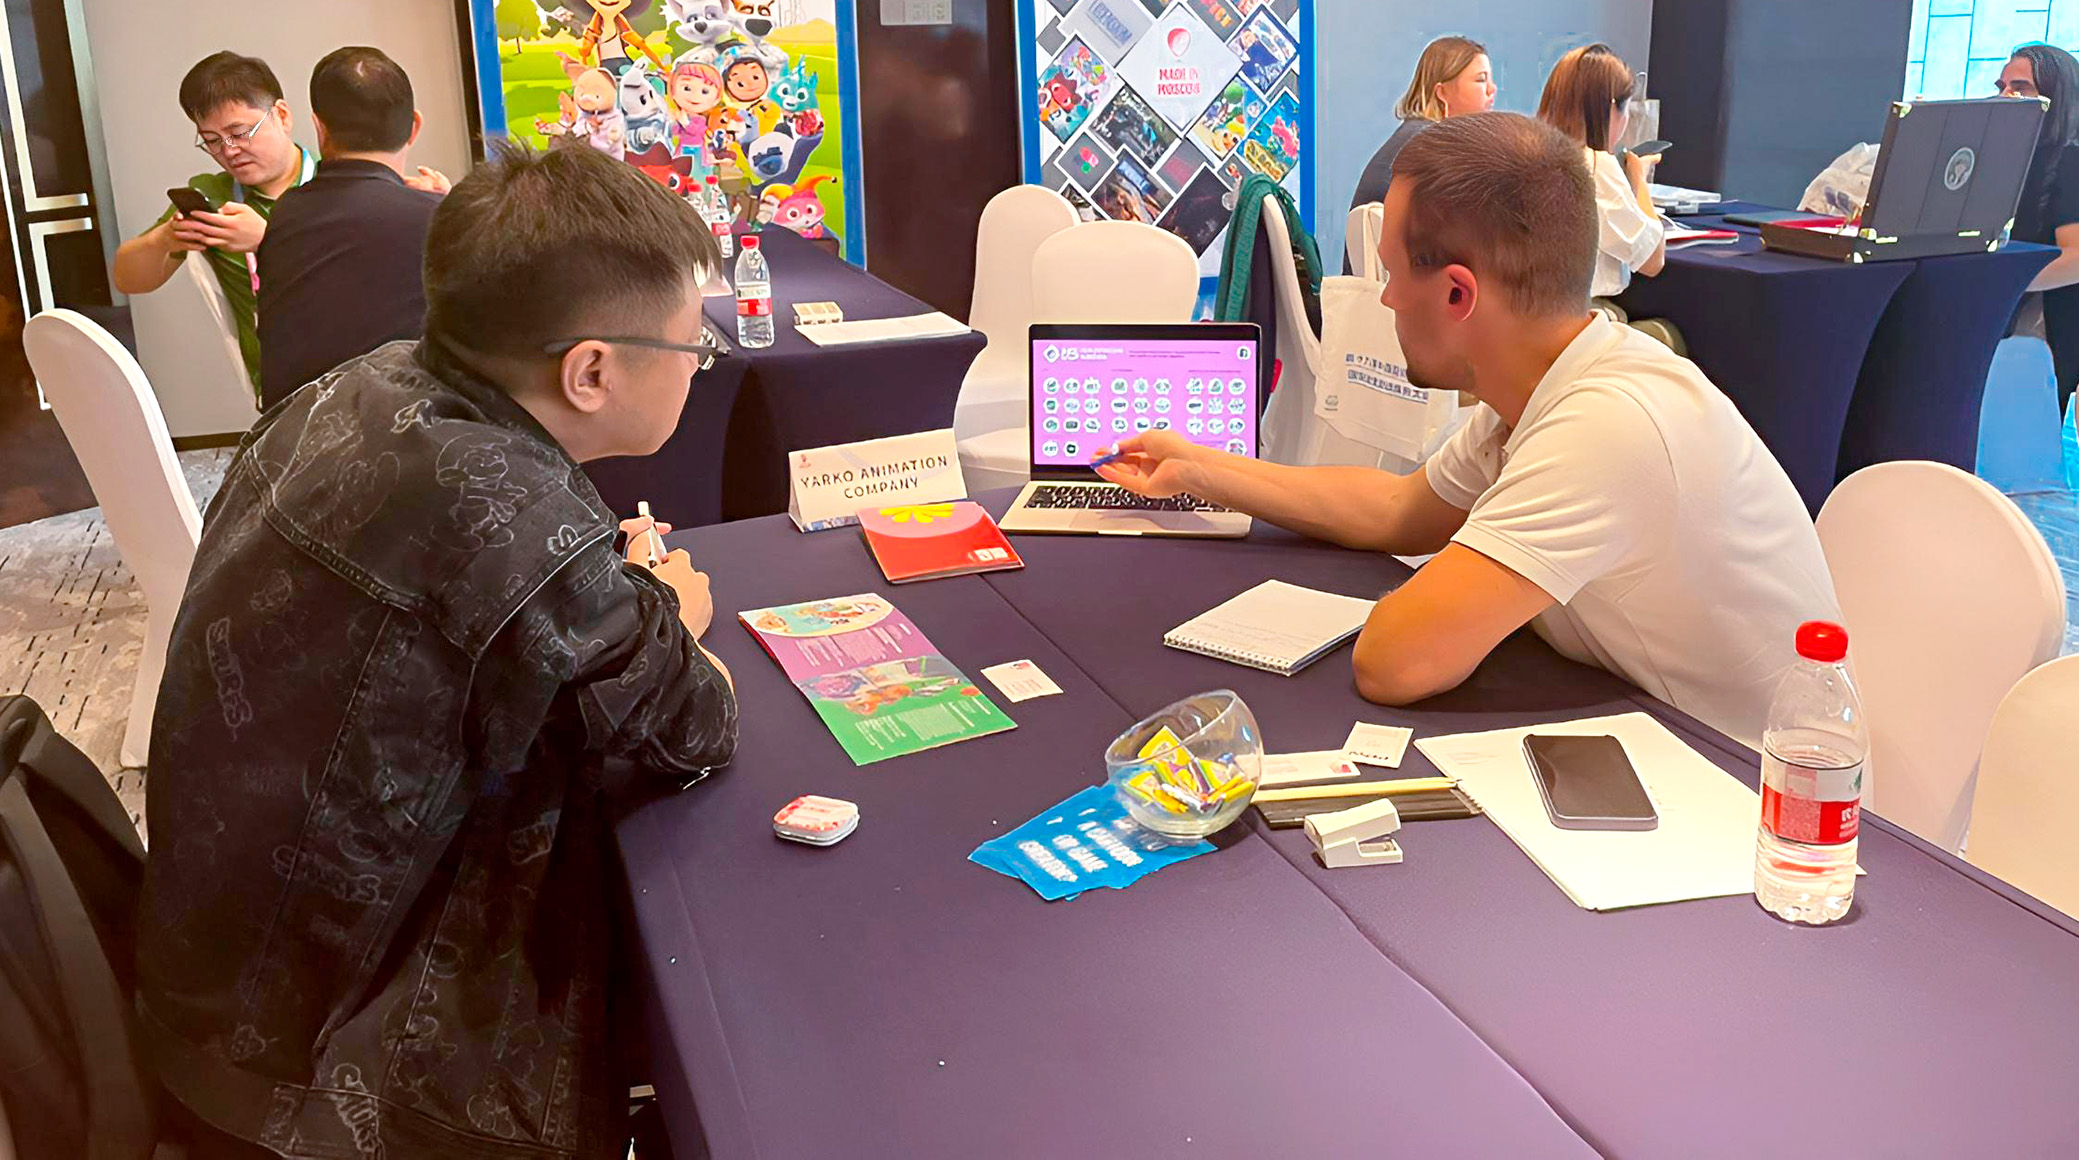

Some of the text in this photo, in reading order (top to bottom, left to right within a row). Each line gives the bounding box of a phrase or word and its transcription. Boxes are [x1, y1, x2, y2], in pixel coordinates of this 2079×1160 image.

[800, 455, 948, 489] YARKO ANIMATION
[843, 476, 919, 499] COMPANY
